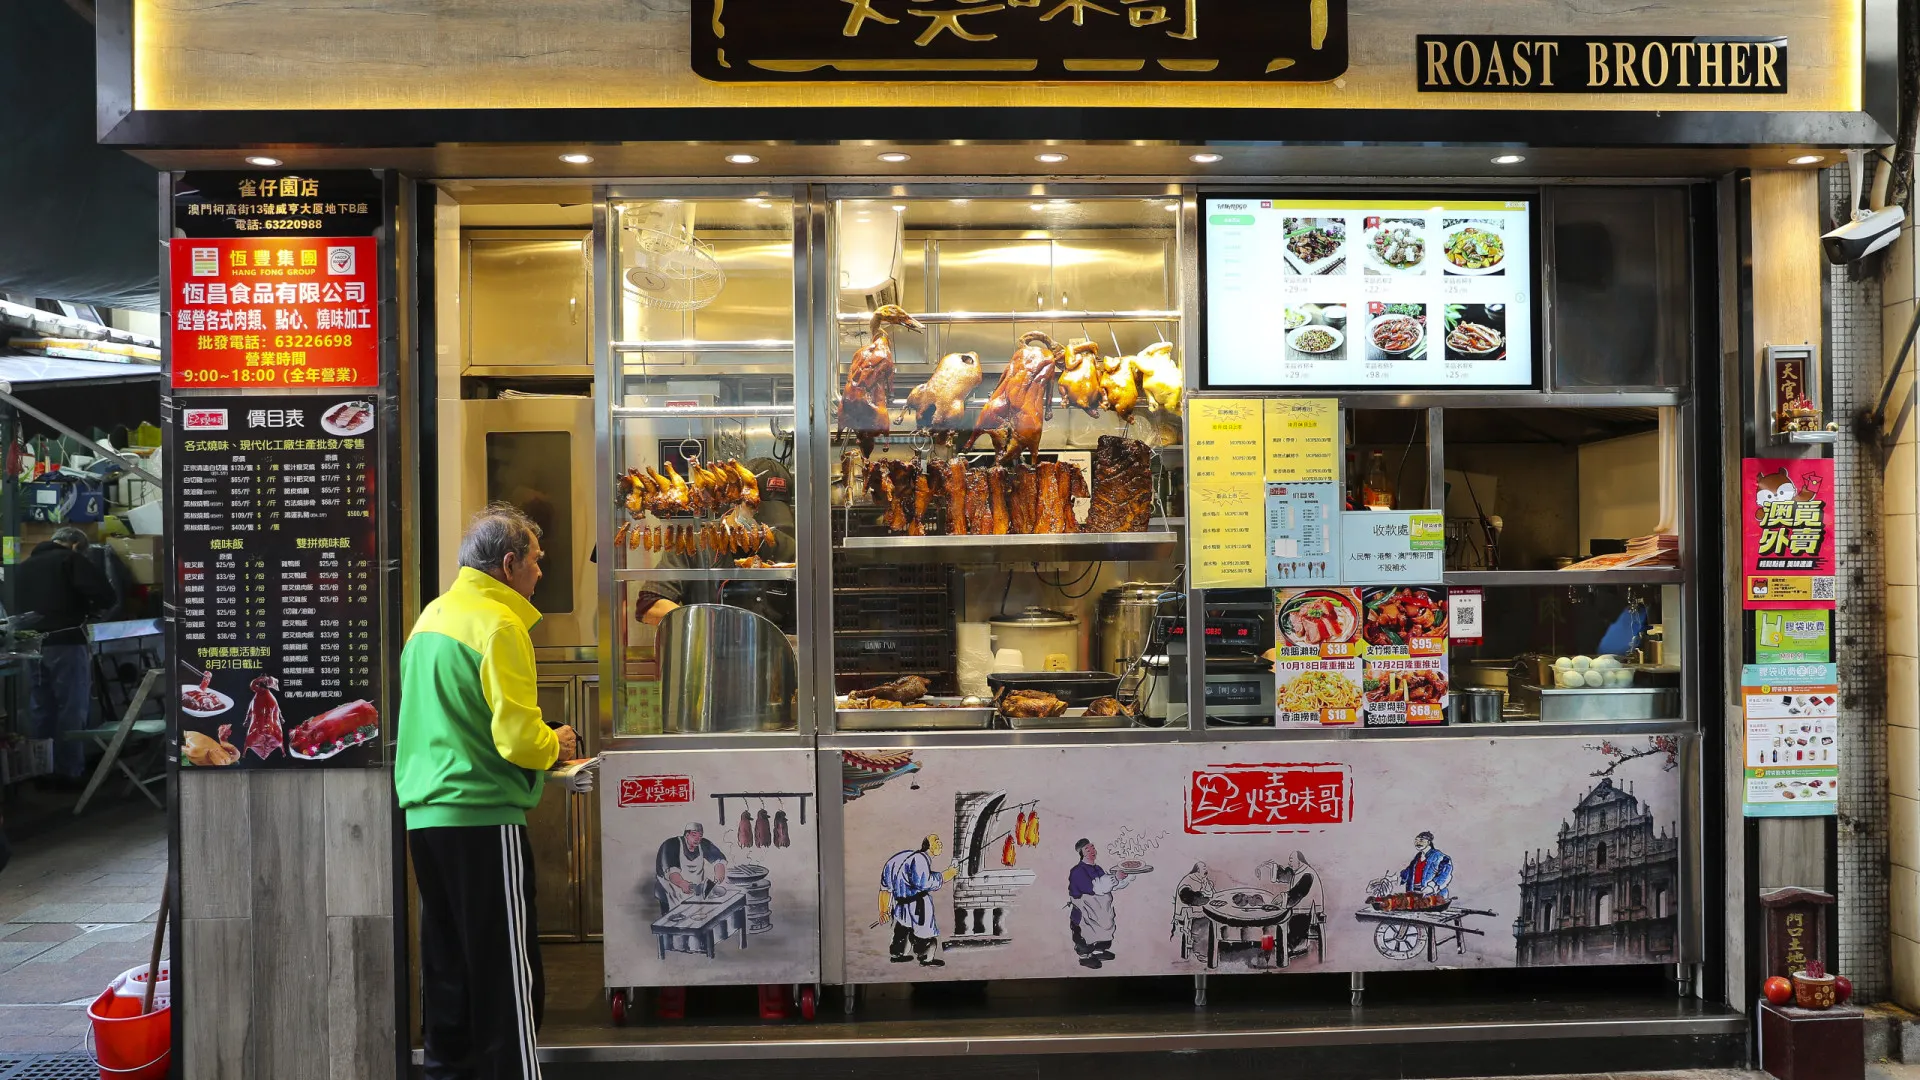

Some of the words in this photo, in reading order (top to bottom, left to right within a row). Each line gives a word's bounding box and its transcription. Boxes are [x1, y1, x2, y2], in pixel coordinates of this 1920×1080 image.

[1424, 41, 1558, 86] ROAST
[1586, 42, 1781, 87] BROTHER
[238, 178, 320, 198] 雀仔園店
[266, 220, 322, 230] 63220988
[230, 250, 318, 267] 恆豐集團
[232, 268, 256, 276] HANG
[260, 268, 283, 276] FONG
[287, 268, 316, 276] GROUP
[182, 282, 365, 304] 恆昌食品有限公司
[178, 308, 372, 331] 經營各式肉類、點心、燒味加工
[275, 335, 352, 348] 63226698
[246, 352, 306, 367] 營業時間
[246, 410, 304, 428] 價目表
[1760, 500, 1823, 527] 澳覓
[1373, 524, 1409, 536] 收款處
[210, 539, 243, 549] 燒味飯
[296, 538, 350, 548] 雙拼燒味飯
[1758, 528, 1822, 554] 外賣
[1378, 564, 1407, 572] 不設補水
[1785, 621, 1825, 632] 膠袋收費
[198, 647, 270, 657] 特價優惠活動到
[1327, 644, 1347, 654] $38
[206, 659, 263, 669] 8月21日截止
[1281, 661, 1355, 670] 10月18日隆重推出
[1372, 660, 1440, 669] 12月2日隆重推出
[1328, 710, 1346, 720] $18
[645, 779, 688, 802] 燒味哥
[1246, 773, 1341, 822] 燒味哥
